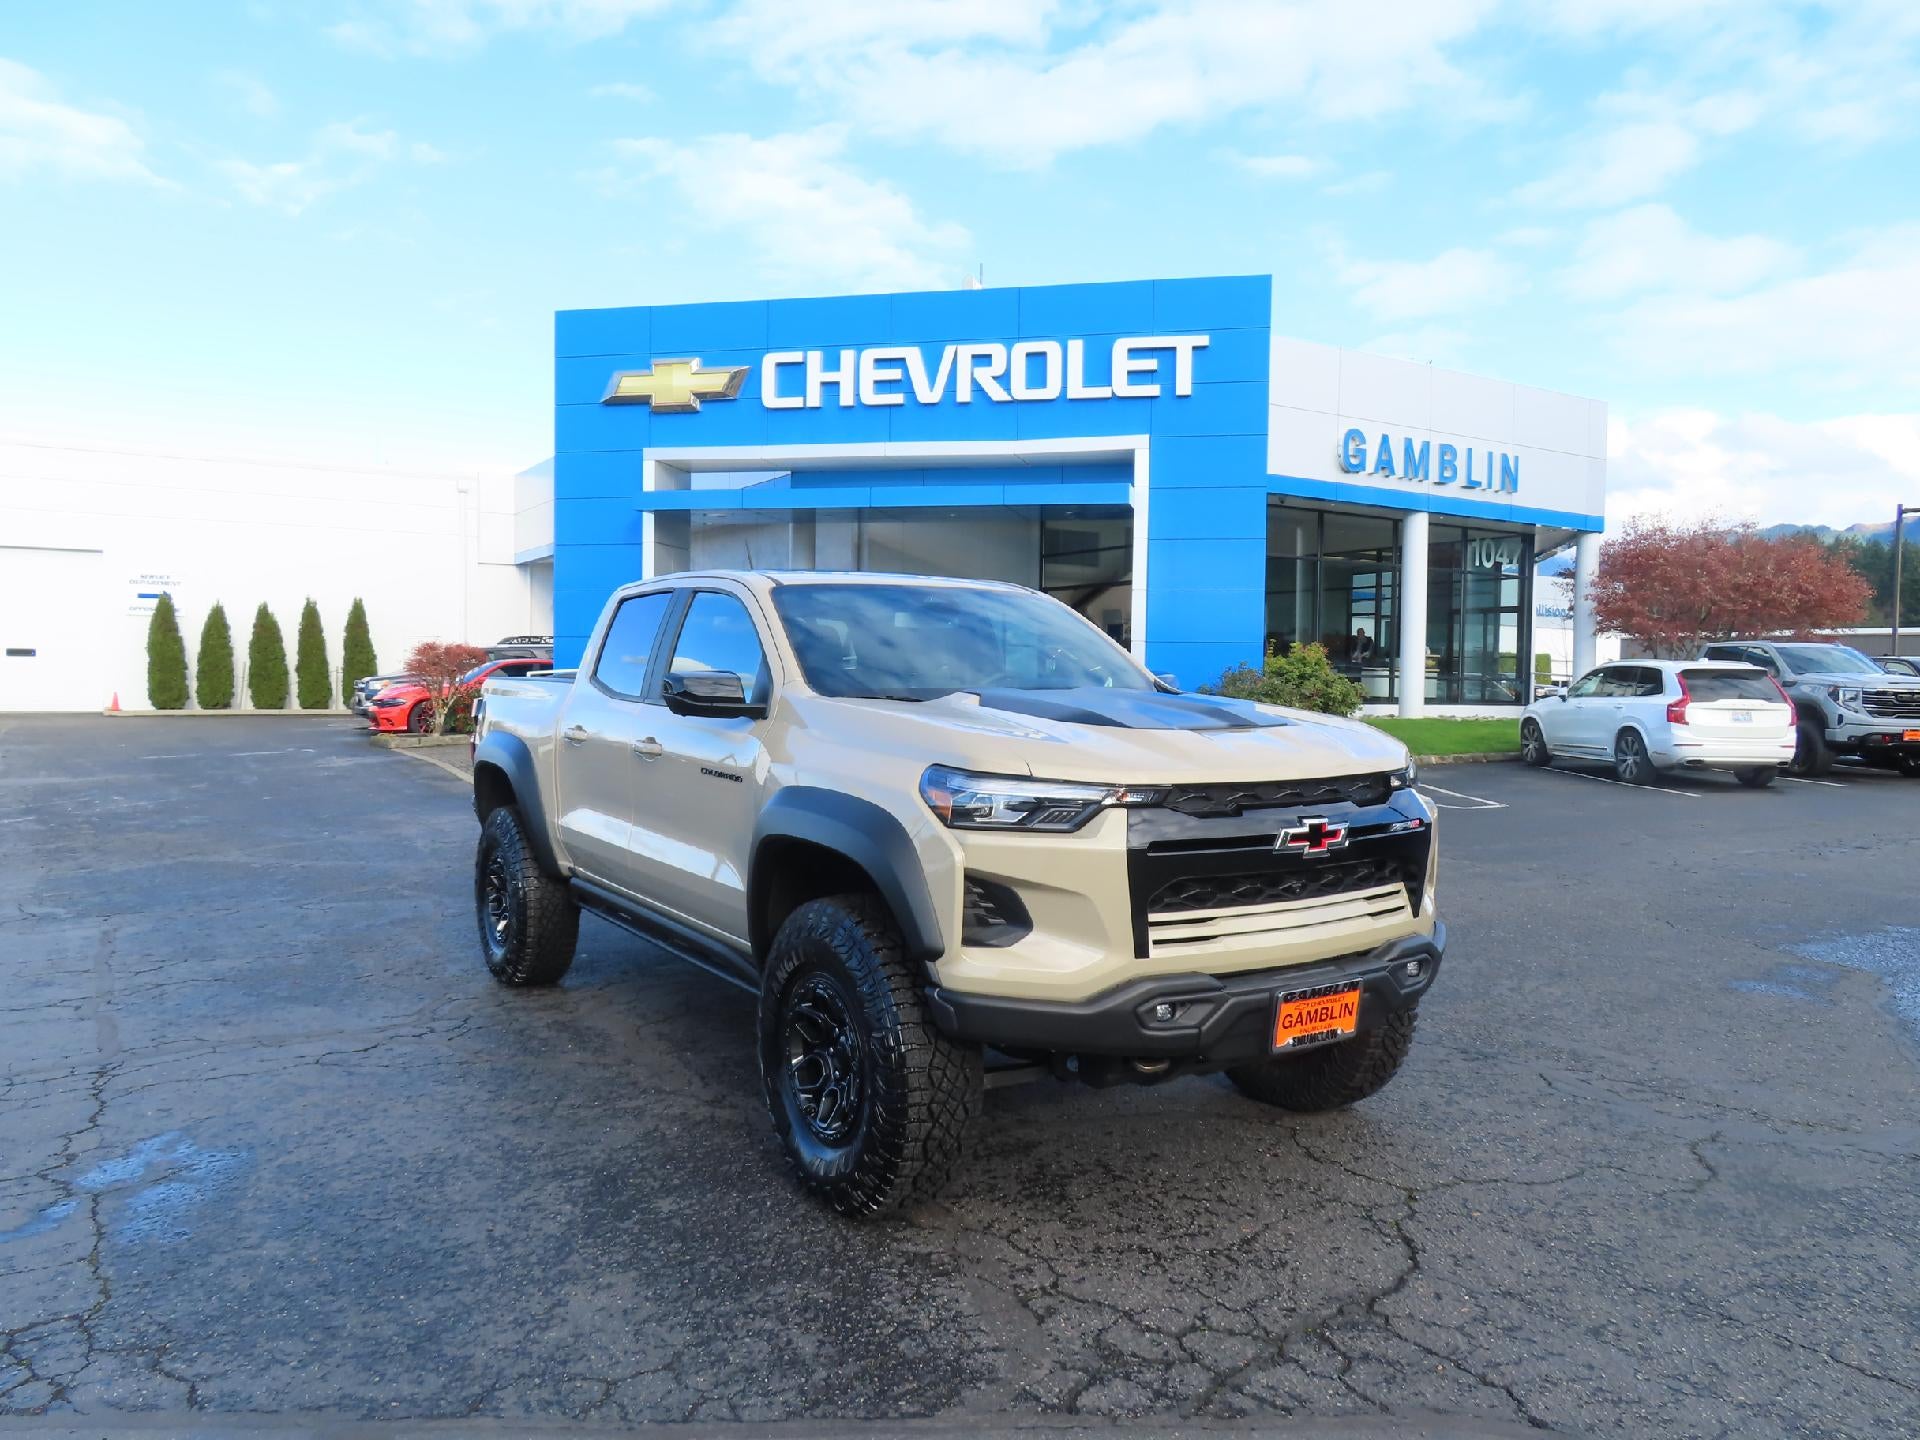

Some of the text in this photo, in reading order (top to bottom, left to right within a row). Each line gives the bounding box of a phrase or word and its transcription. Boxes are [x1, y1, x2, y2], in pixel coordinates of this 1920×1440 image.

[761, 335, 1210, 409] CHEVROLET
[1341, 428, 1520, 494] GAMBLIN
[1281, 1002, 1355, 1029] GAMBLIN
